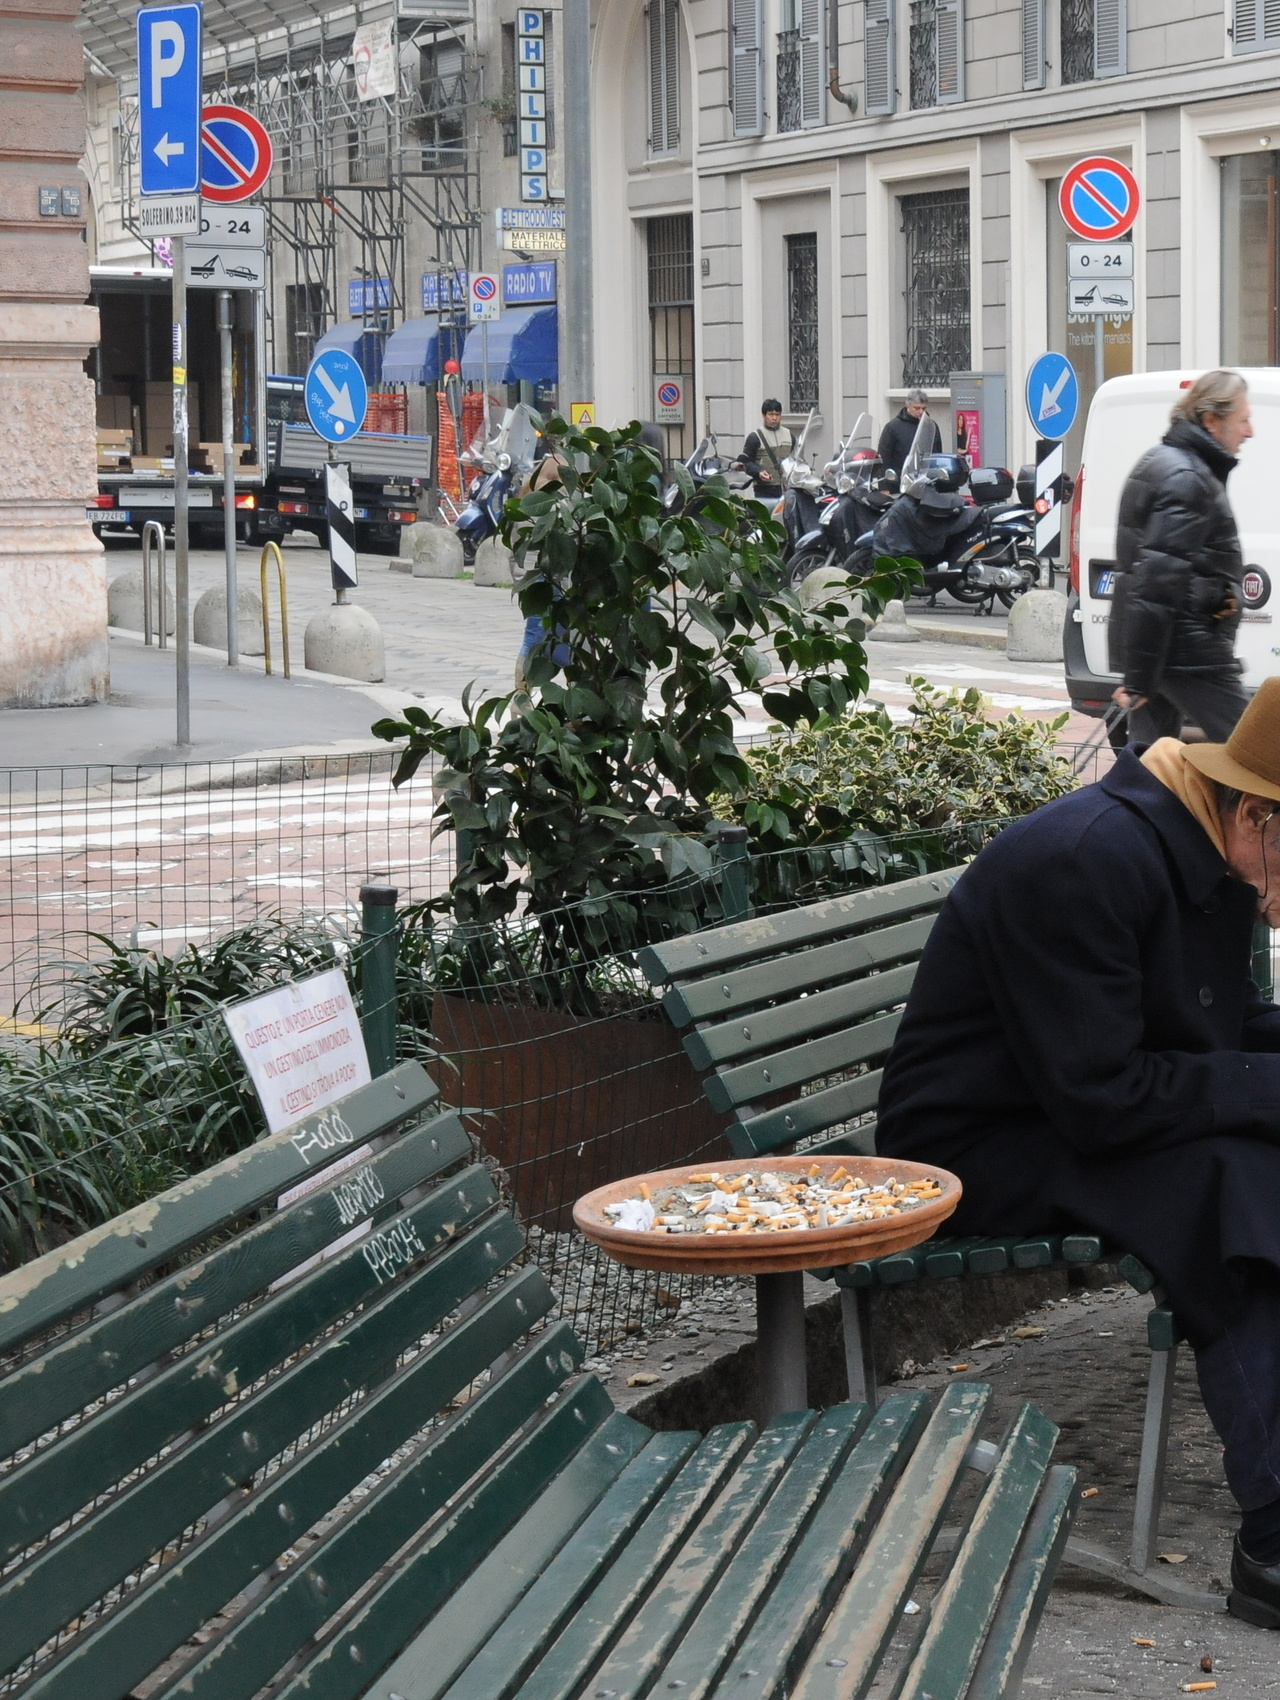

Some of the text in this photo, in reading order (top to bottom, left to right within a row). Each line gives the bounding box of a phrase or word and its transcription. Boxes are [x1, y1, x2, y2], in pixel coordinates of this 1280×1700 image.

[150, 20, 185, 108] P
[524, 13, 542, 198] PHILIPS
[228, 220, 251, 234] 24
[502, 208, 566, 228] ELETTRODOMEST
[512, 232, 566, 241] MATERIALE
[512, 241, 566, 250] ELETTRICO
[1103, 255, 1122, 267] 24
[507, 271, 552, 294] RADIO TV
[1068, 332, 1080, 346] The
[1080, 332, 1095, 346] kitch
[1246, 580, 1259, 593] FIAT
[244, 1023, 277, 1049] QUESTO
[282, 1017, 295, 1033] UN
[292, 1008, 315, 1029] PORTA
[313, 998, 337, 1020] CENERE
[276, 1048, 304, 1073] CESTINO
[286, 1084, 312, 1110] CESTINO
